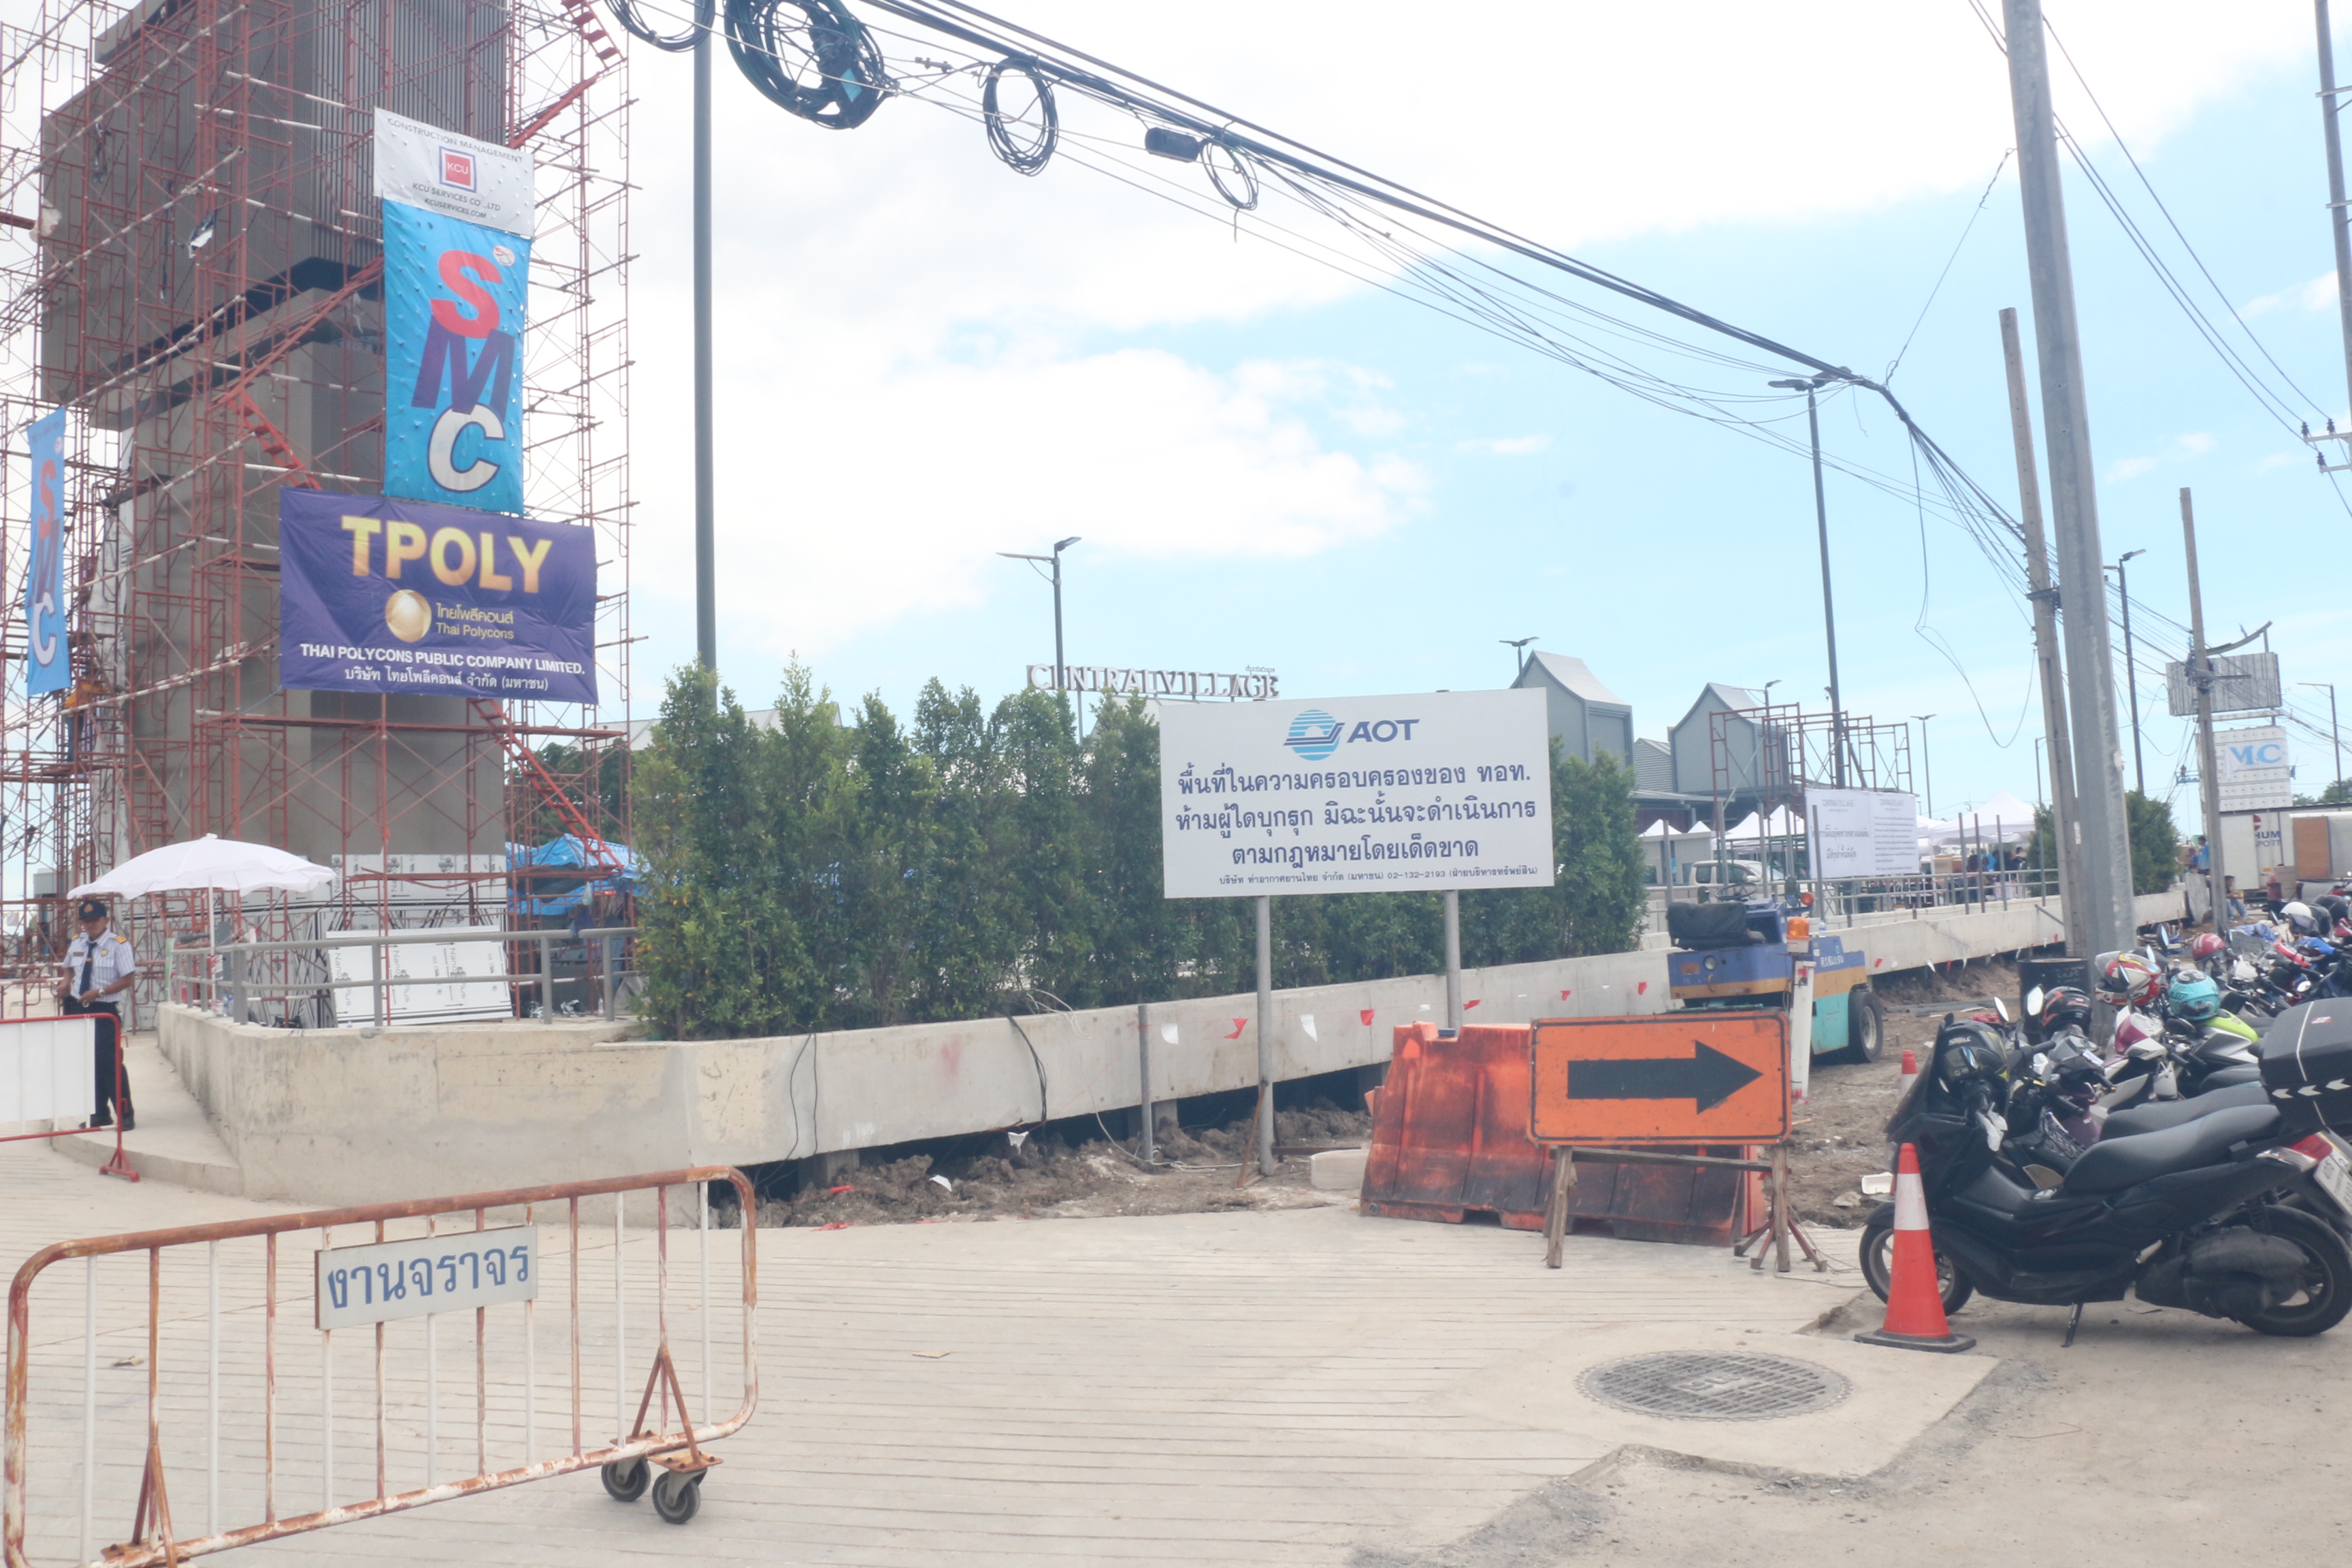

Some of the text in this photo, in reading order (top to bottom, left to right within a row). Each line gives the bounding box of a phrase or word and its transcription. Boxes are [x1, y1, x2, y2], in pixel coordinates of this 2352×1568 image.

[387, 118, 523, 163] CONSTRUCTION MANAGEMENT
[446, 161, 469, 175] KCU
[412, 182, 430, 193] KCU
[431, 186, 468, 203] SERVICES
[424, 197, 487, 218] KCUSERVICES.COM
[341, 514, 553, 593] TPOLY
[436, 602, 514, 624] ไทยโพลีคอนส์
[436, 622, 514, 640] Thai Polycons
[300, 643, 585, 675] THAI POLYCONS PUBLIC COMPANY LIMITED.
[344, 666, 549, 691] บริษัท ไทยโพลีคอนส์ จำกัด (มหาชน)
[1347, 719, 1420, 743] AOT
[1178, 762, 1531, 794] พื้นที่ในความครอบครองของ ทอท.
[1175, 790, 1537, 839] ห้ามผู้ใดบุกรุก มิฉะนั้นจะดำเนินการ
[1232, 832, 1480, 868] ตามกฎหมายโดยเด็ดขาด
[1219, 874, 1244, 885] บริษัท
[1387, 870, 1446, 880] 02-132-2193
[327, 1245, 529, 1309] งานจราจร
